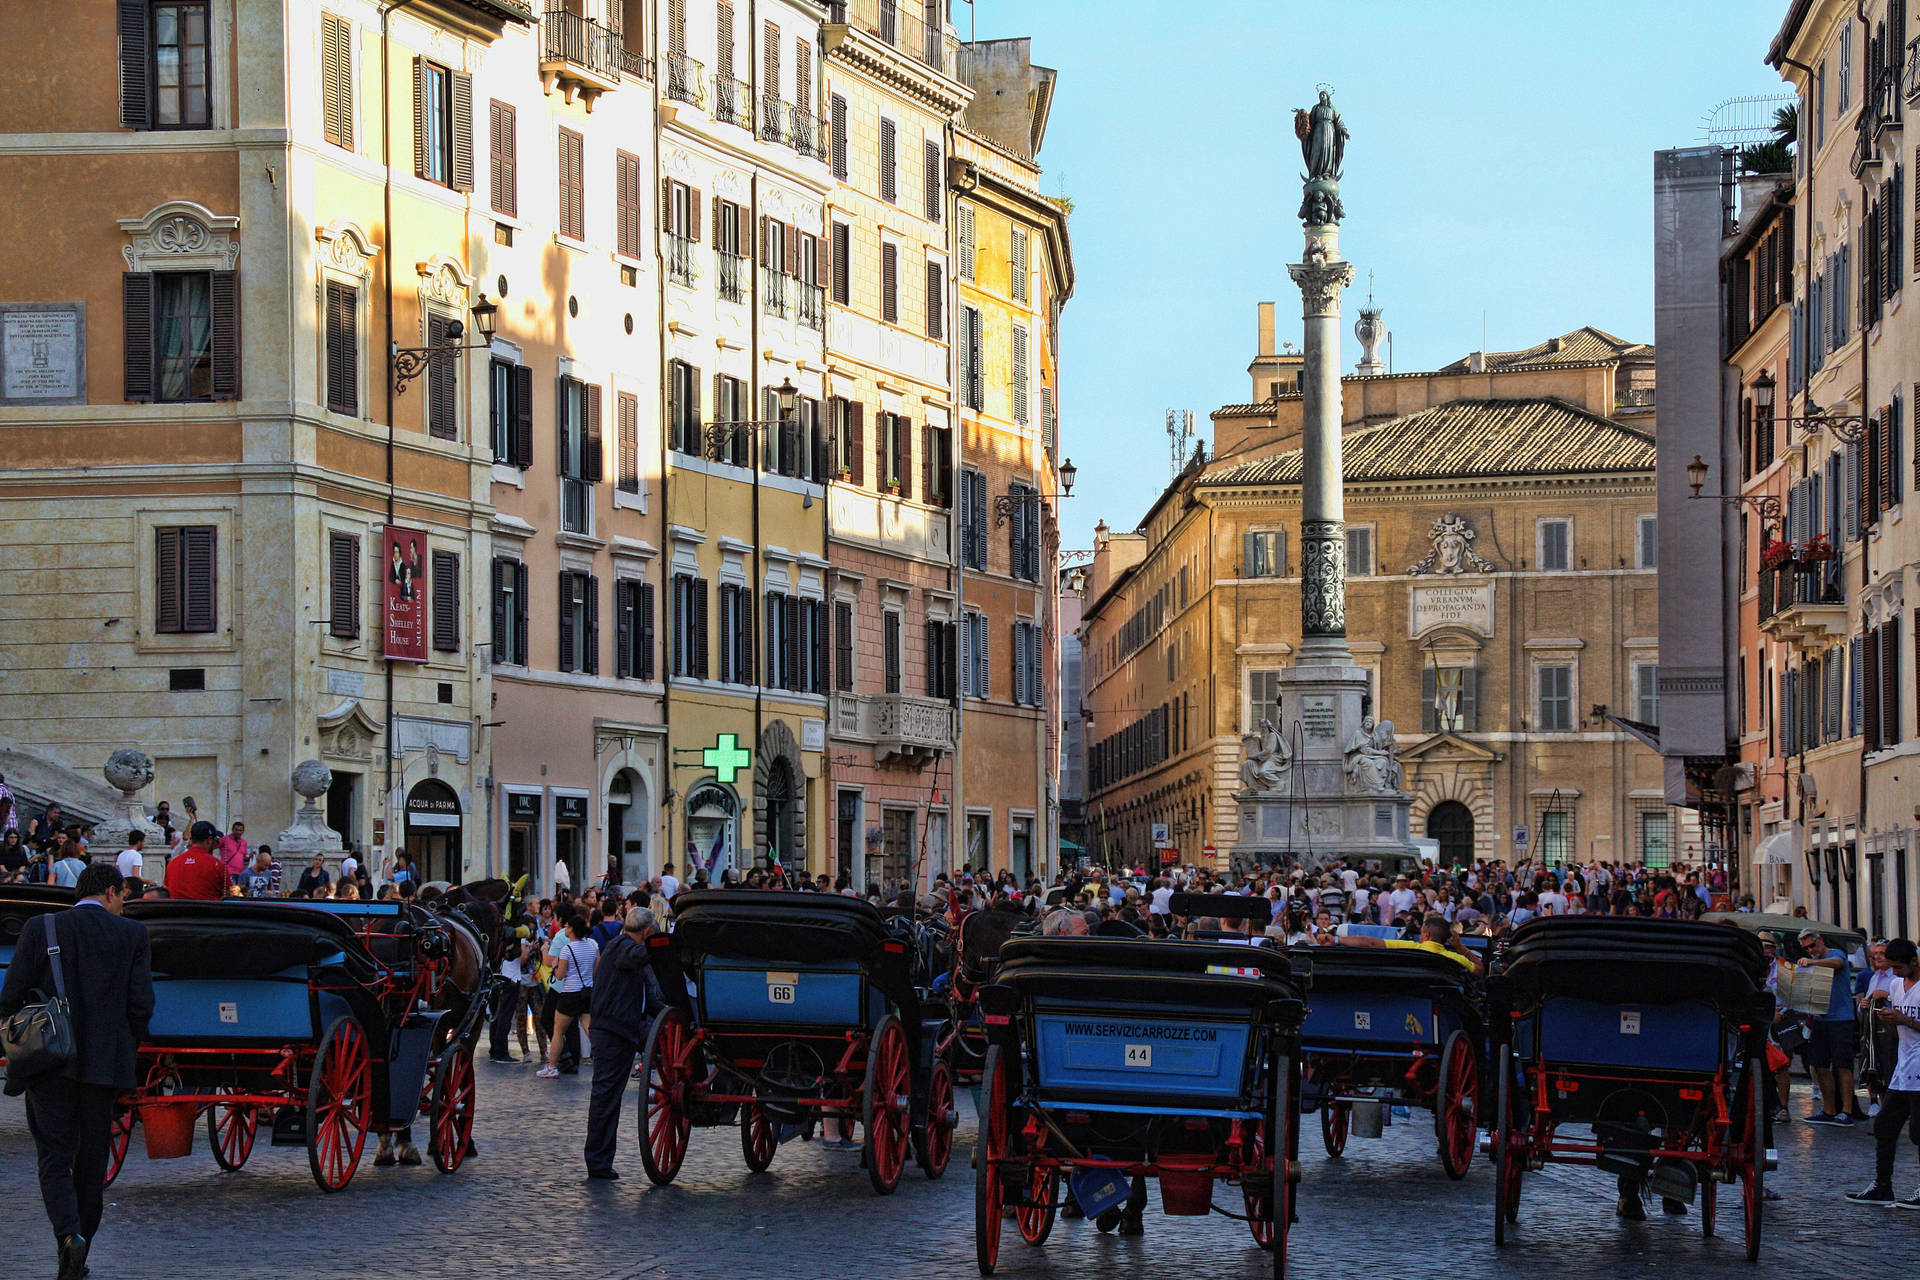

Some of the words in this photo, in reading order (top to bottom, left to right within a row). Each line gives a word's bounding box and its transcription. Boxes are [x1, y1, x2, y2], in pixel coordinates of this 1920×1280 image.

[1426, 588, 1477, 596] COLLEGIVM
[1430, 596, 1473, 604] VRBANVM
[390, 613, 413, 629] SHELLEY
[390, 630, 409, 646] HOUSE
[408, 799, 429, 809] ACQUA
[436, 801, 455, 809] PARMA
[774, 987, 790, 1000] 66
[1065, 1023, 1217, 1042] WWW.SERVIZICARROZZE.COM
[1128, 1049, 1147, 1061] 44
